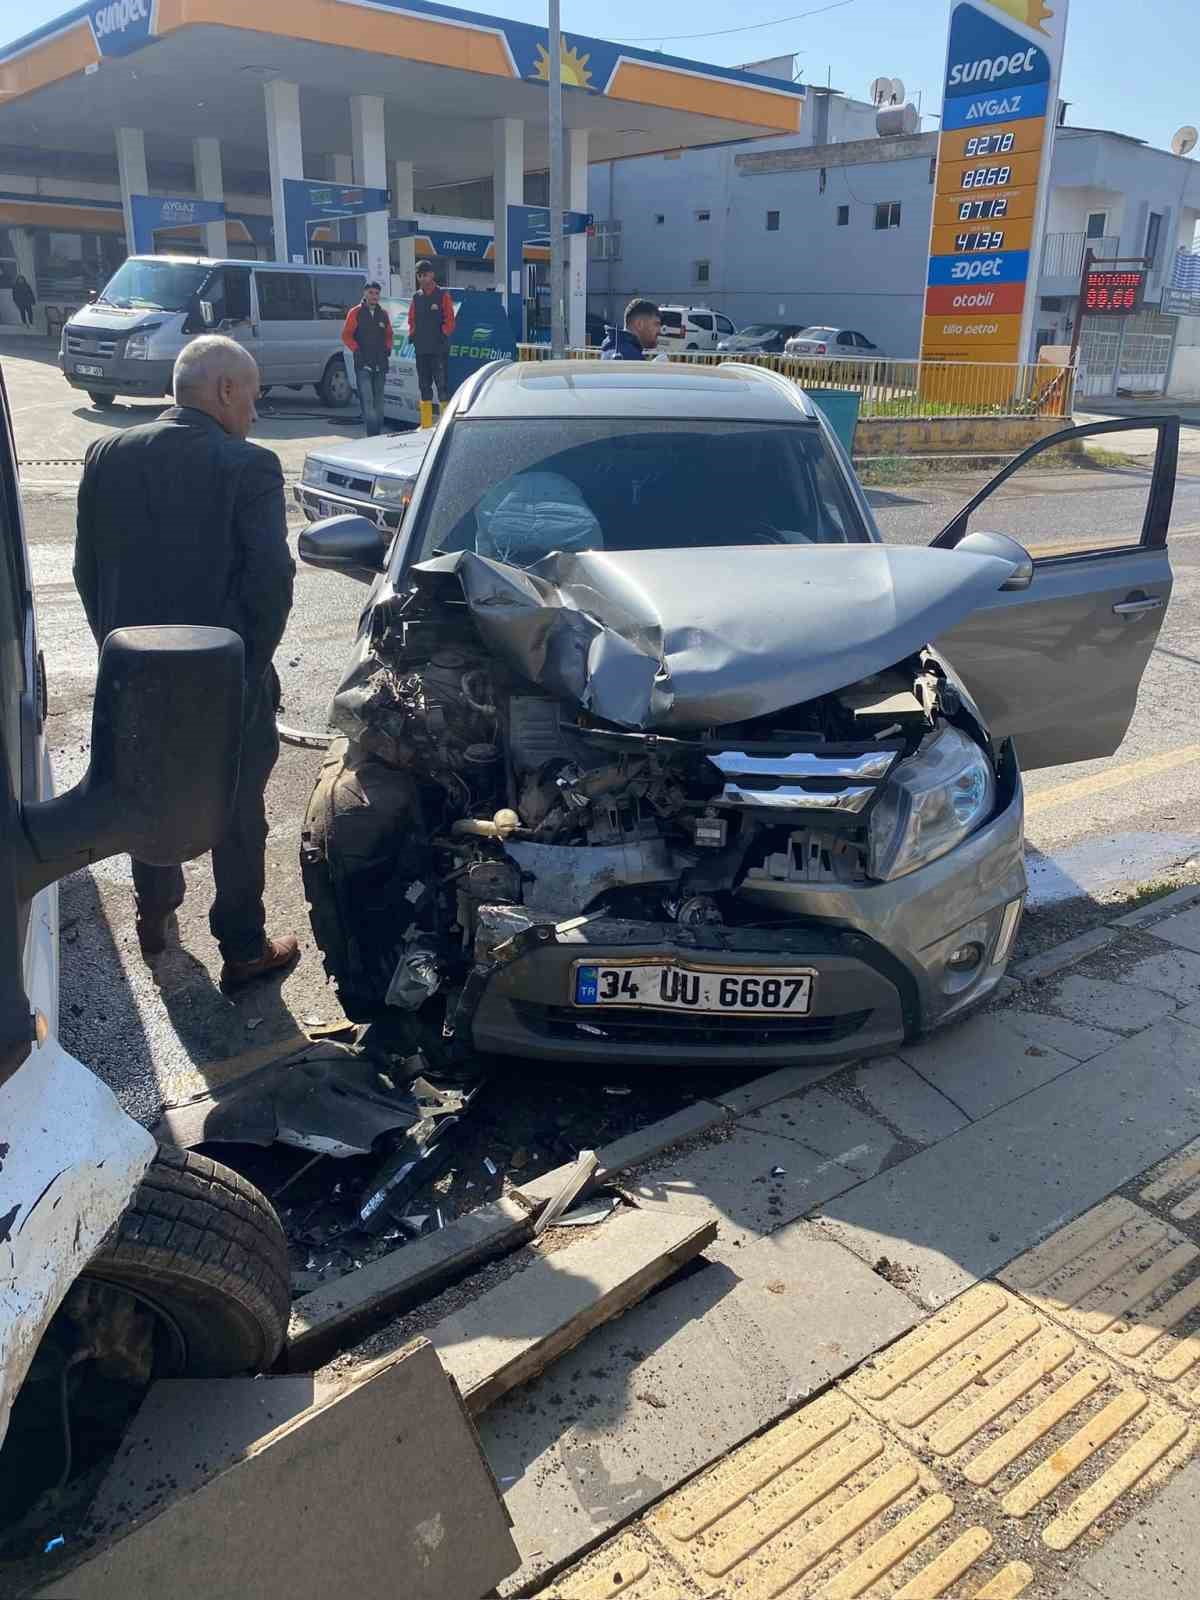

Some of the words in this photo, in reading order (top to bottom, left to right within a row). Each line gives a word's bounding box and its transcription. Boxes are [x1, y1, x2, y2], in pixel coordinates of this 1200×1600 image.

[949, 47, 1037, 86] sunpet
[965, 95, 1022, 120] AYGAZ
[442, 238, 478, 252] market
[952, 292, 994, 307] otobil
[580, 985, 597, 997] TR
[600, 970, 639, 999] 34
[719, 977, 804, 1009] 6687
